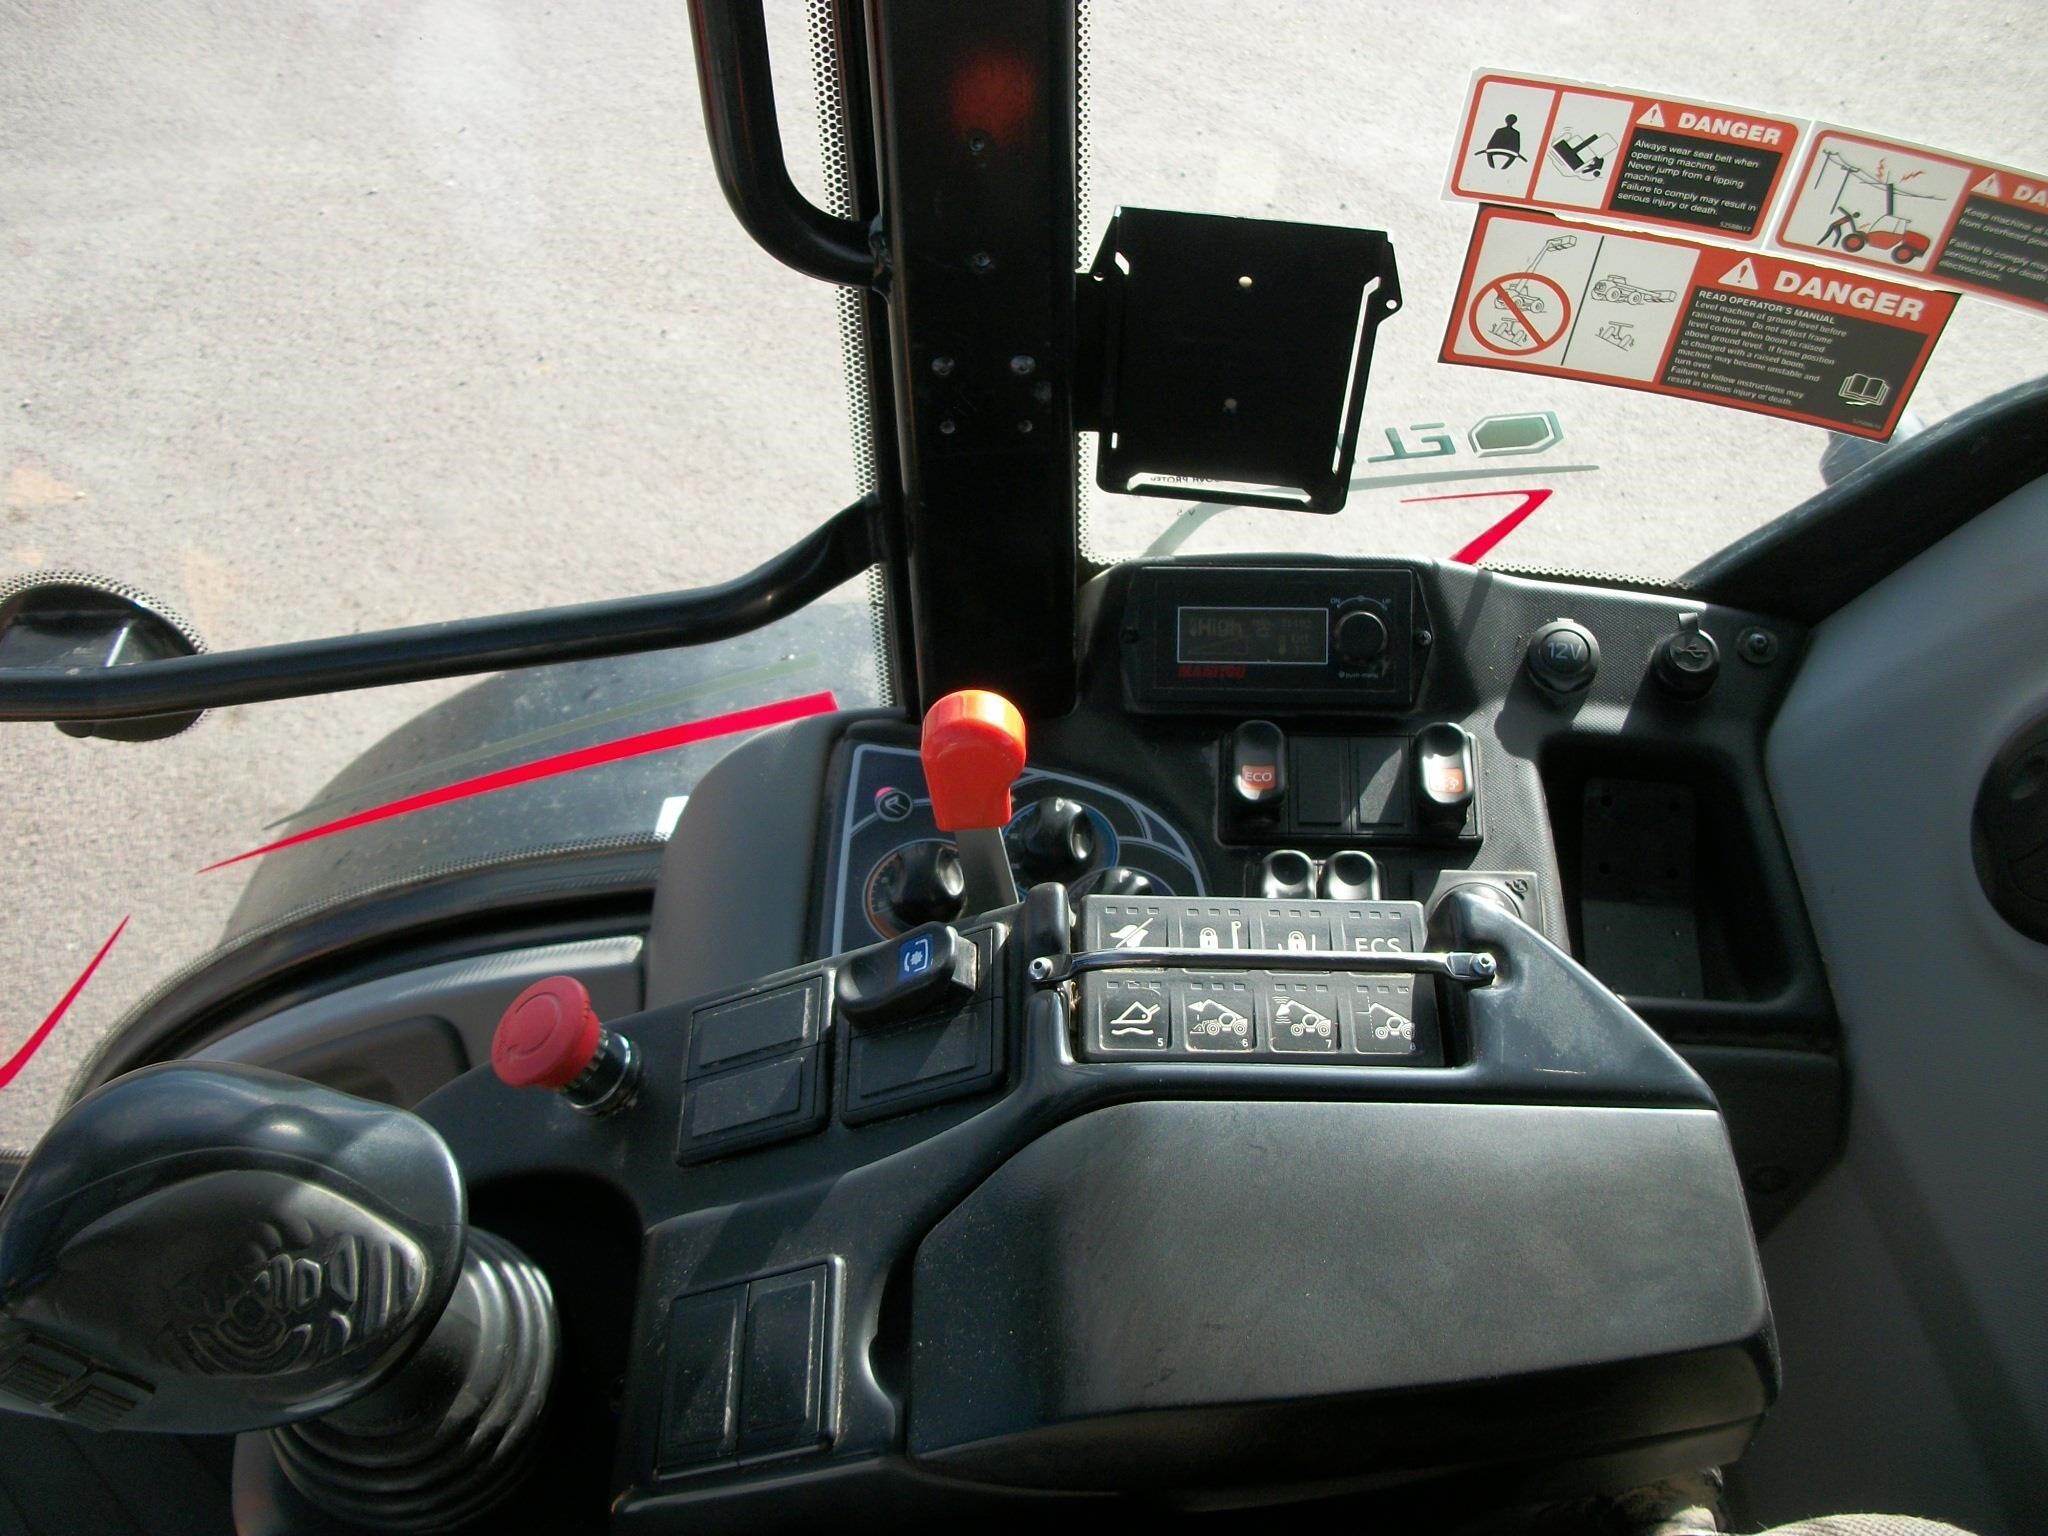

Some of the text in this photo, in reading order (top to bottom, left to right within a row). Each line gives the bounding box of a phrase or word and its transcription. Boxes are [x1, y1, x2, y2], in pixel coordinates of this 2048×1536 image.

[1678, 112, 1782, 145] DANGER
[1631, 151, 1717, 172] operating machine.
[1634, 139, 1759, 168] Always wear seat belt when
[1624, 171, 1664, 185] machine.
[1628, 161, 1655, 172] Never
[1655, 165, 1680, 178] jump
[1681, 170, 1703, 181] from
[1713, 174, 1744, 190] tipping
[1617, 192, 1718, 216] serious injury or death.
[1621, 181, 1757, 212] Failure to comply may result in
[2012, 184, 2048, 207] DA
[1959, 217, 1981, 230] from
[1964, 207, 1989, 220] Keep
[1990, 214, 2032, 231] machine
[1948, 239, 1980, 253] Failure
[1982, 247, 1992, 256] to
[1993, 251, 2029, 266] comply
[1699, 290, 1835, 325] READ OPERATOR'S MANUAL
[1773, 270, 1926, 322] DANGER
[1691, 310, 1720, 323] raising
[1751, 321, 1764, 330] Do
[1765, 325, 1779, 333] not
[1780, 328, 1807, 340] adjust
[1808, 333, 1833, 345] frame
[1695, 300, 1847, 338] Level machine at ground level before
[1684, 330, 1710, 339] above
[1710, 334, 1741, 346] ground
[1776, 346, 1801, 358] frame
[1801, 352, 1835, 366] position
[1688, 320, 1709, 330] level
[1709, 324, 1739, 335] control
[1741, 330, 1763, 340] when
[1764, 335, 1788, 345] boom
[1798, 342, 1826, 353] raised
[1674, 357, 1692, 366] turn
[1690, 341, 1726, 353] changed
[1727, 347, 1746, 357] with
[1753, 353, 1780, 364] raised
[1677, 348, 1821, 383] machine may become unstable and
[1670, 366, 1804, 400] Failure to follow instructions may
[1547, 641, 1582, 662] 12V
[1244, 771, 1272, 782] ECO
[1354, 937, 1402, 952] ECS
[1157, 1037, 1164, 1047] 5
[1242, 1038, 1249, 1047] 6
[1326, 1039, 1333, 1048] 7
